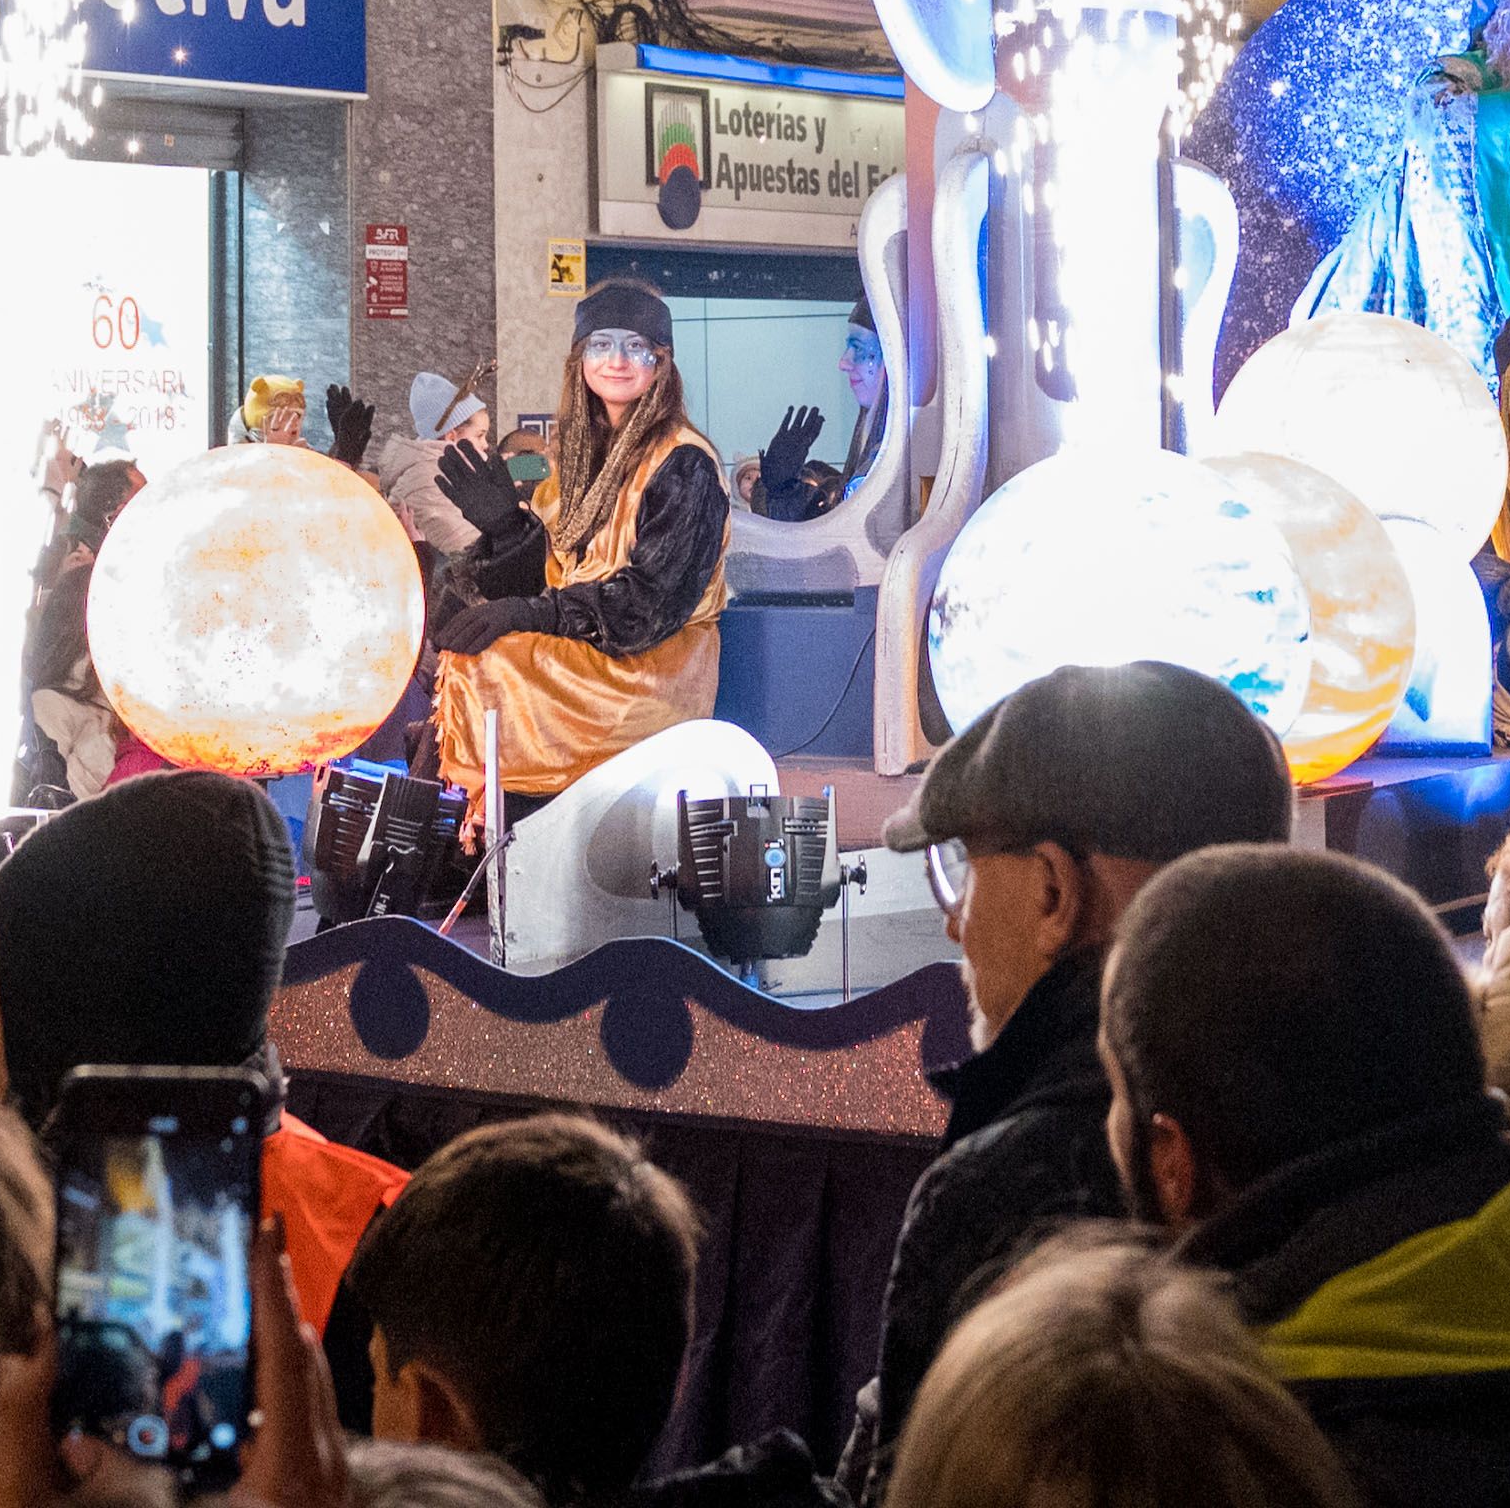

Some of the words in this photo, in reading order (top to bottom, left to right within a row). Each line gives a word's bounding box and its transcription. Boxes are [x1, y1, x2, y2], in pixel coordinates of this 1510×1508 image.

[714, 96, 808, 143] Loterías
[814, 116, 827, 155] y
[716, 152, 821, 201] Apuestas
[827, 159, 860, 199] del
[92, 294, 140, 350] 60
